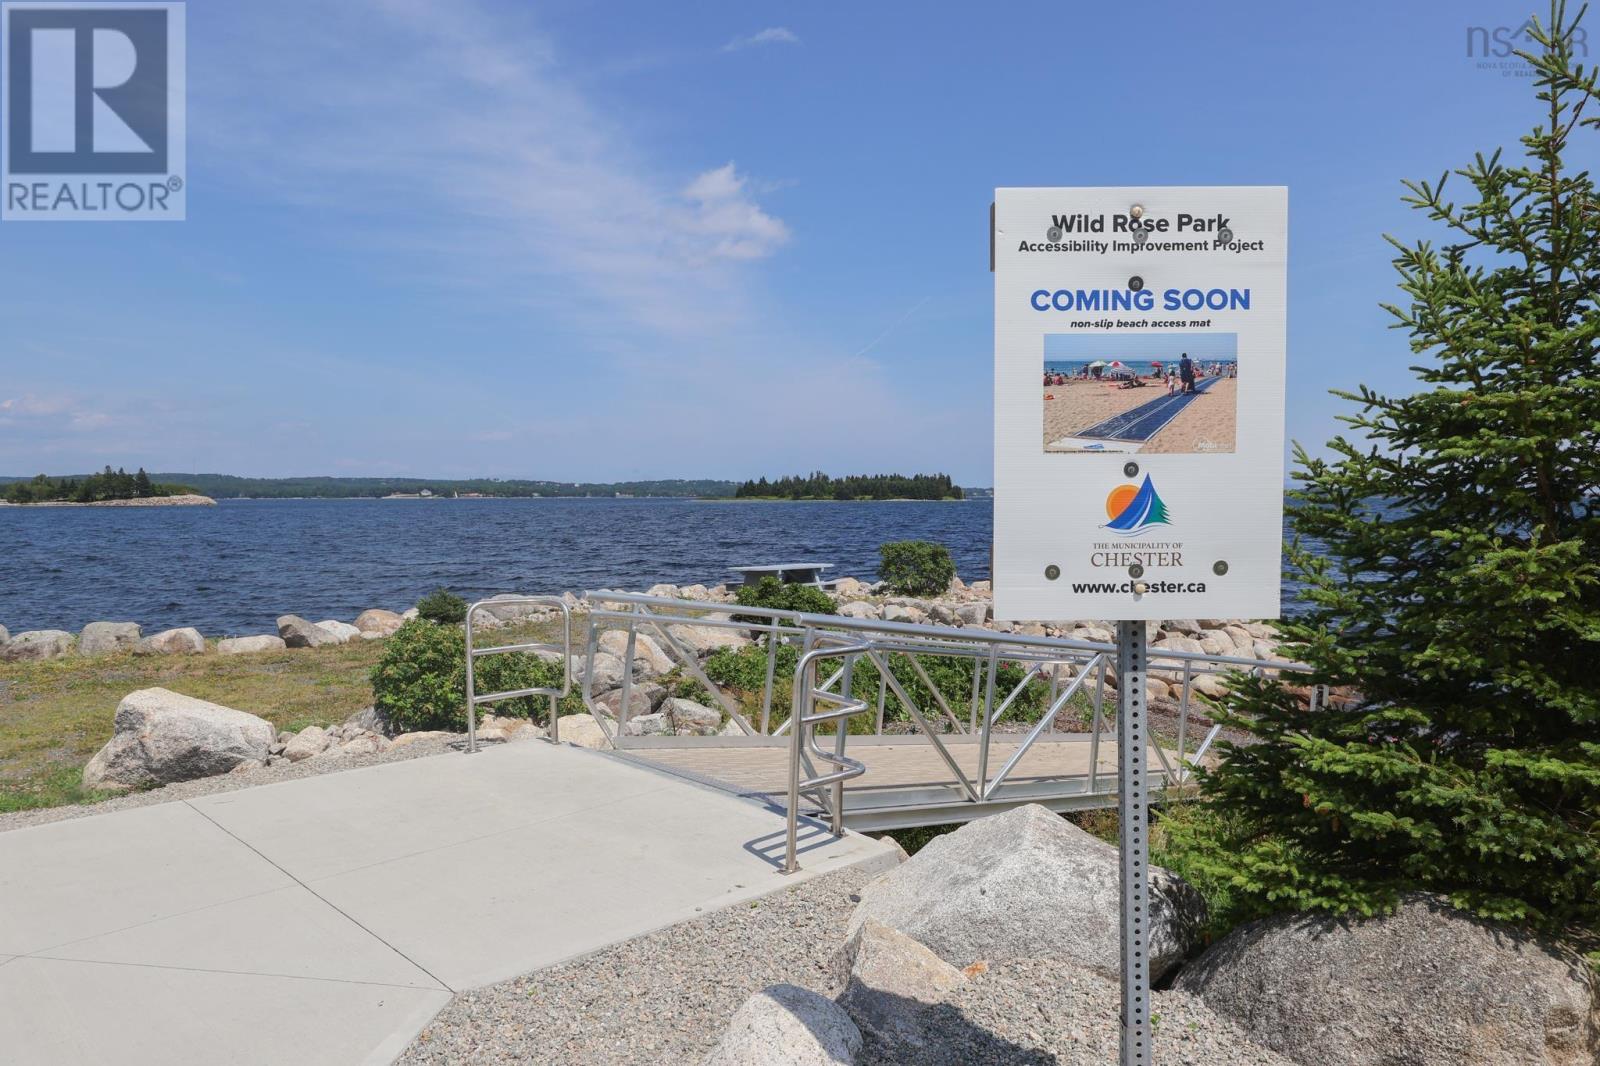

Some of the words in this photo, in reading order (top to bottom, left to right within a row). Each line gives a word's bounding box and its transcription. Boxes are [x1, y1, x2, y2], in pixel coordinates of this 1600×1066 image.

[1052, 214, 1105, 233] Wild
[1112, 214, 1169, 233] Rose
[1177, 213, 1231, 233] Park
[1018, 239, 1109, 254] Accessibility
[1112, 239, 1209, 254] Improvement
[1213, 239, 1264, 254] Project
[1030, 289, 1155, 312] COMING
[1163, 288, 1251, 311] SOON
[1070, 318, 1114, 329] non-slip
[1116, 318, 1149, 328] beach
[1151, 319, 1187, 328] access
[1189, 318, 1211, 328] mat
[1093, 542, 1110, 550] THE
[1112, 542, 1170, 550] MUNICIPALITY
[1172, 542, 1184, 550] OF
[1090, 552, 1184, 568] CHESTER
[1072, 580, 1207, 594] www.chester.ca
